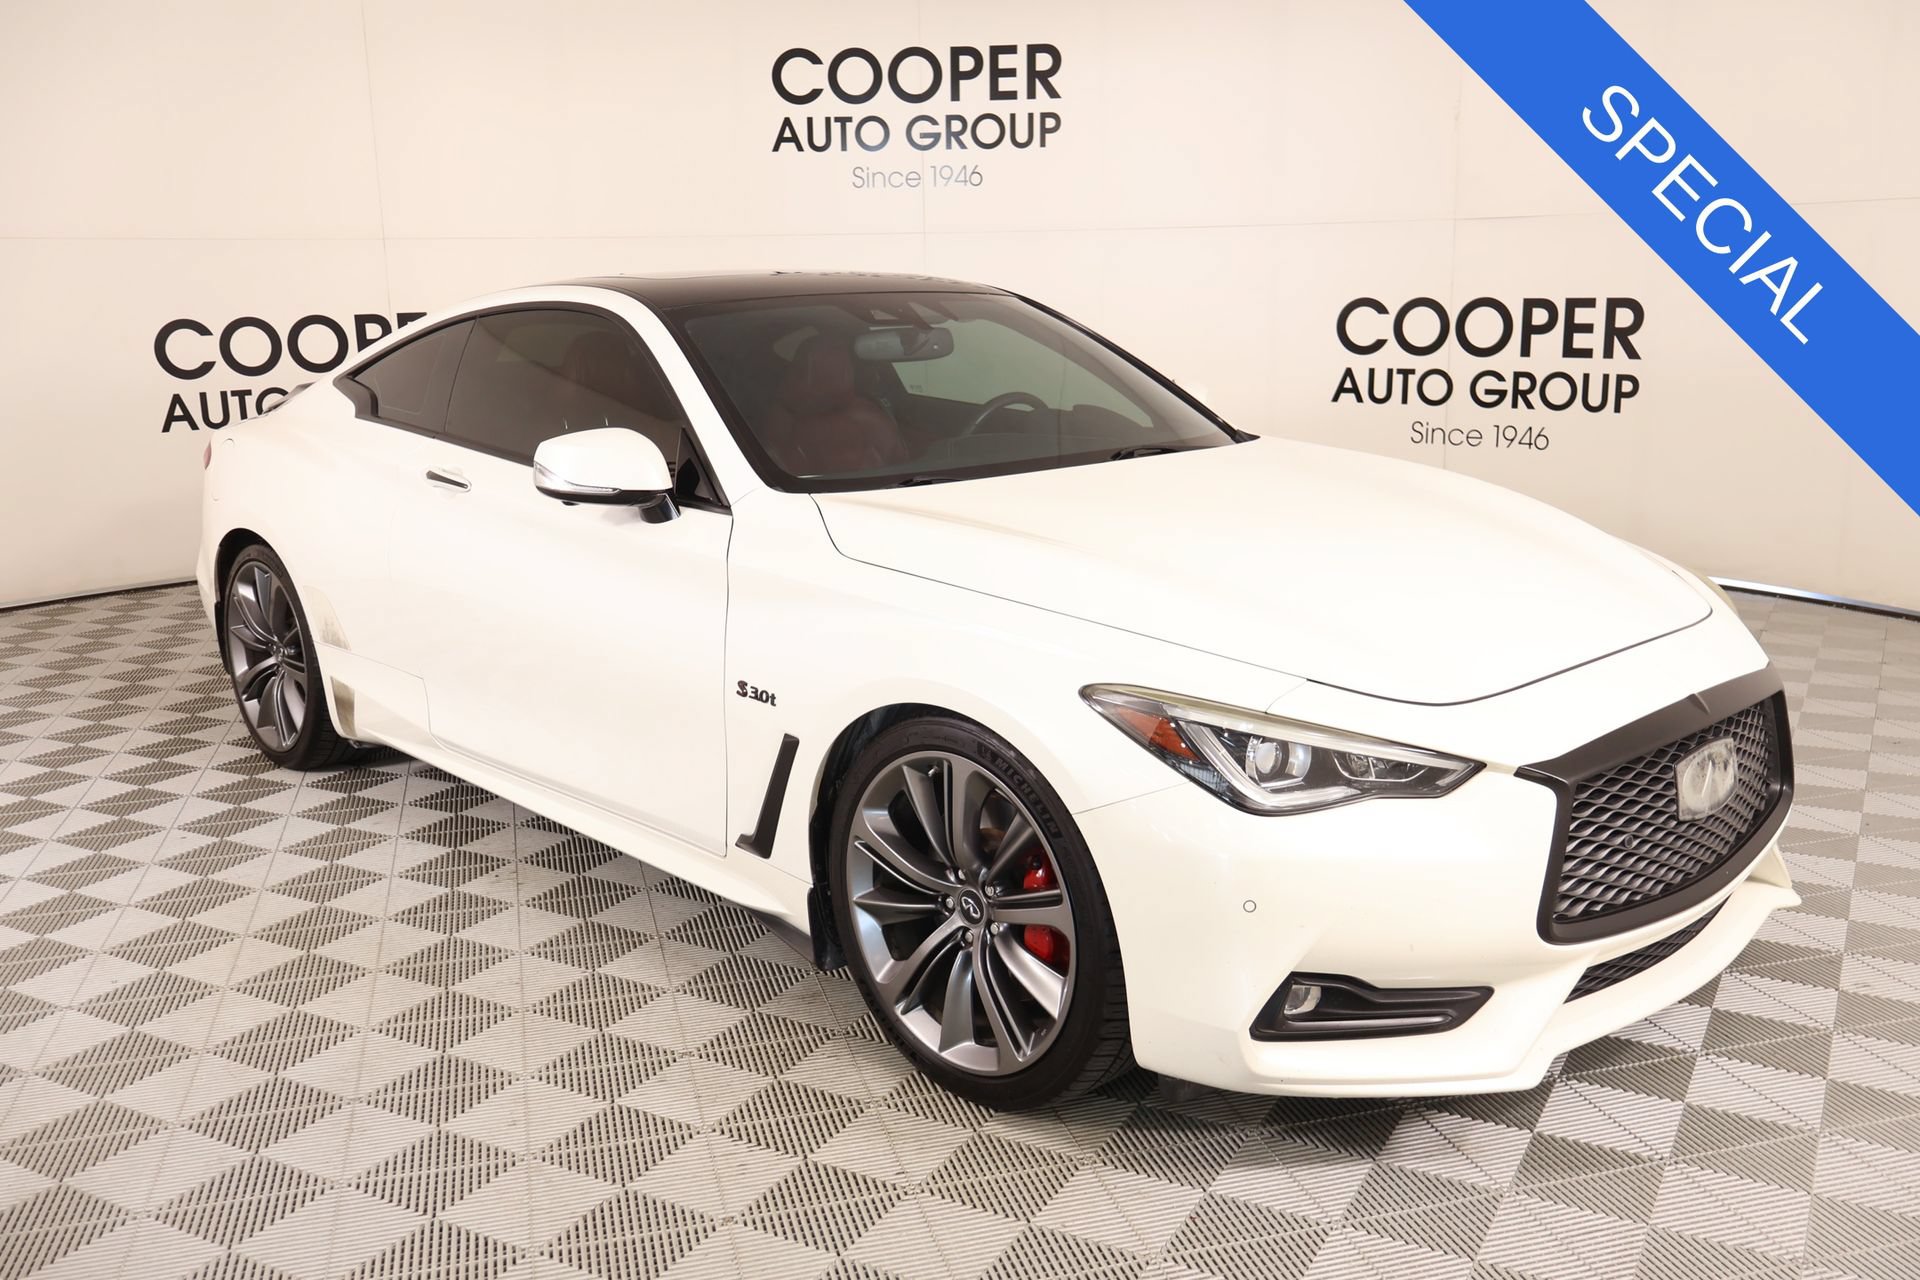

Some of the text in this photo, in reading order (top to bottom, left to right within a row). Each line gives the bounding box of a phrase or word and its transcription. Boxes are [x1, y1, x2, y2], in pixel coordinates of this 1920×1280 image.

[771, 44, 1063, 105] COOPER
[771, 111, 1062, 153] AUTO GROUP
[851, 164, 983, 189] Since 1946
[1336, 296, 1645, 360] COOPER
[1331, 367, 1640, 414] AUTO GROUP
[1410, 420, 1550, 451] Since 1946
[994, 757, 1060, 834] MICHELIN
